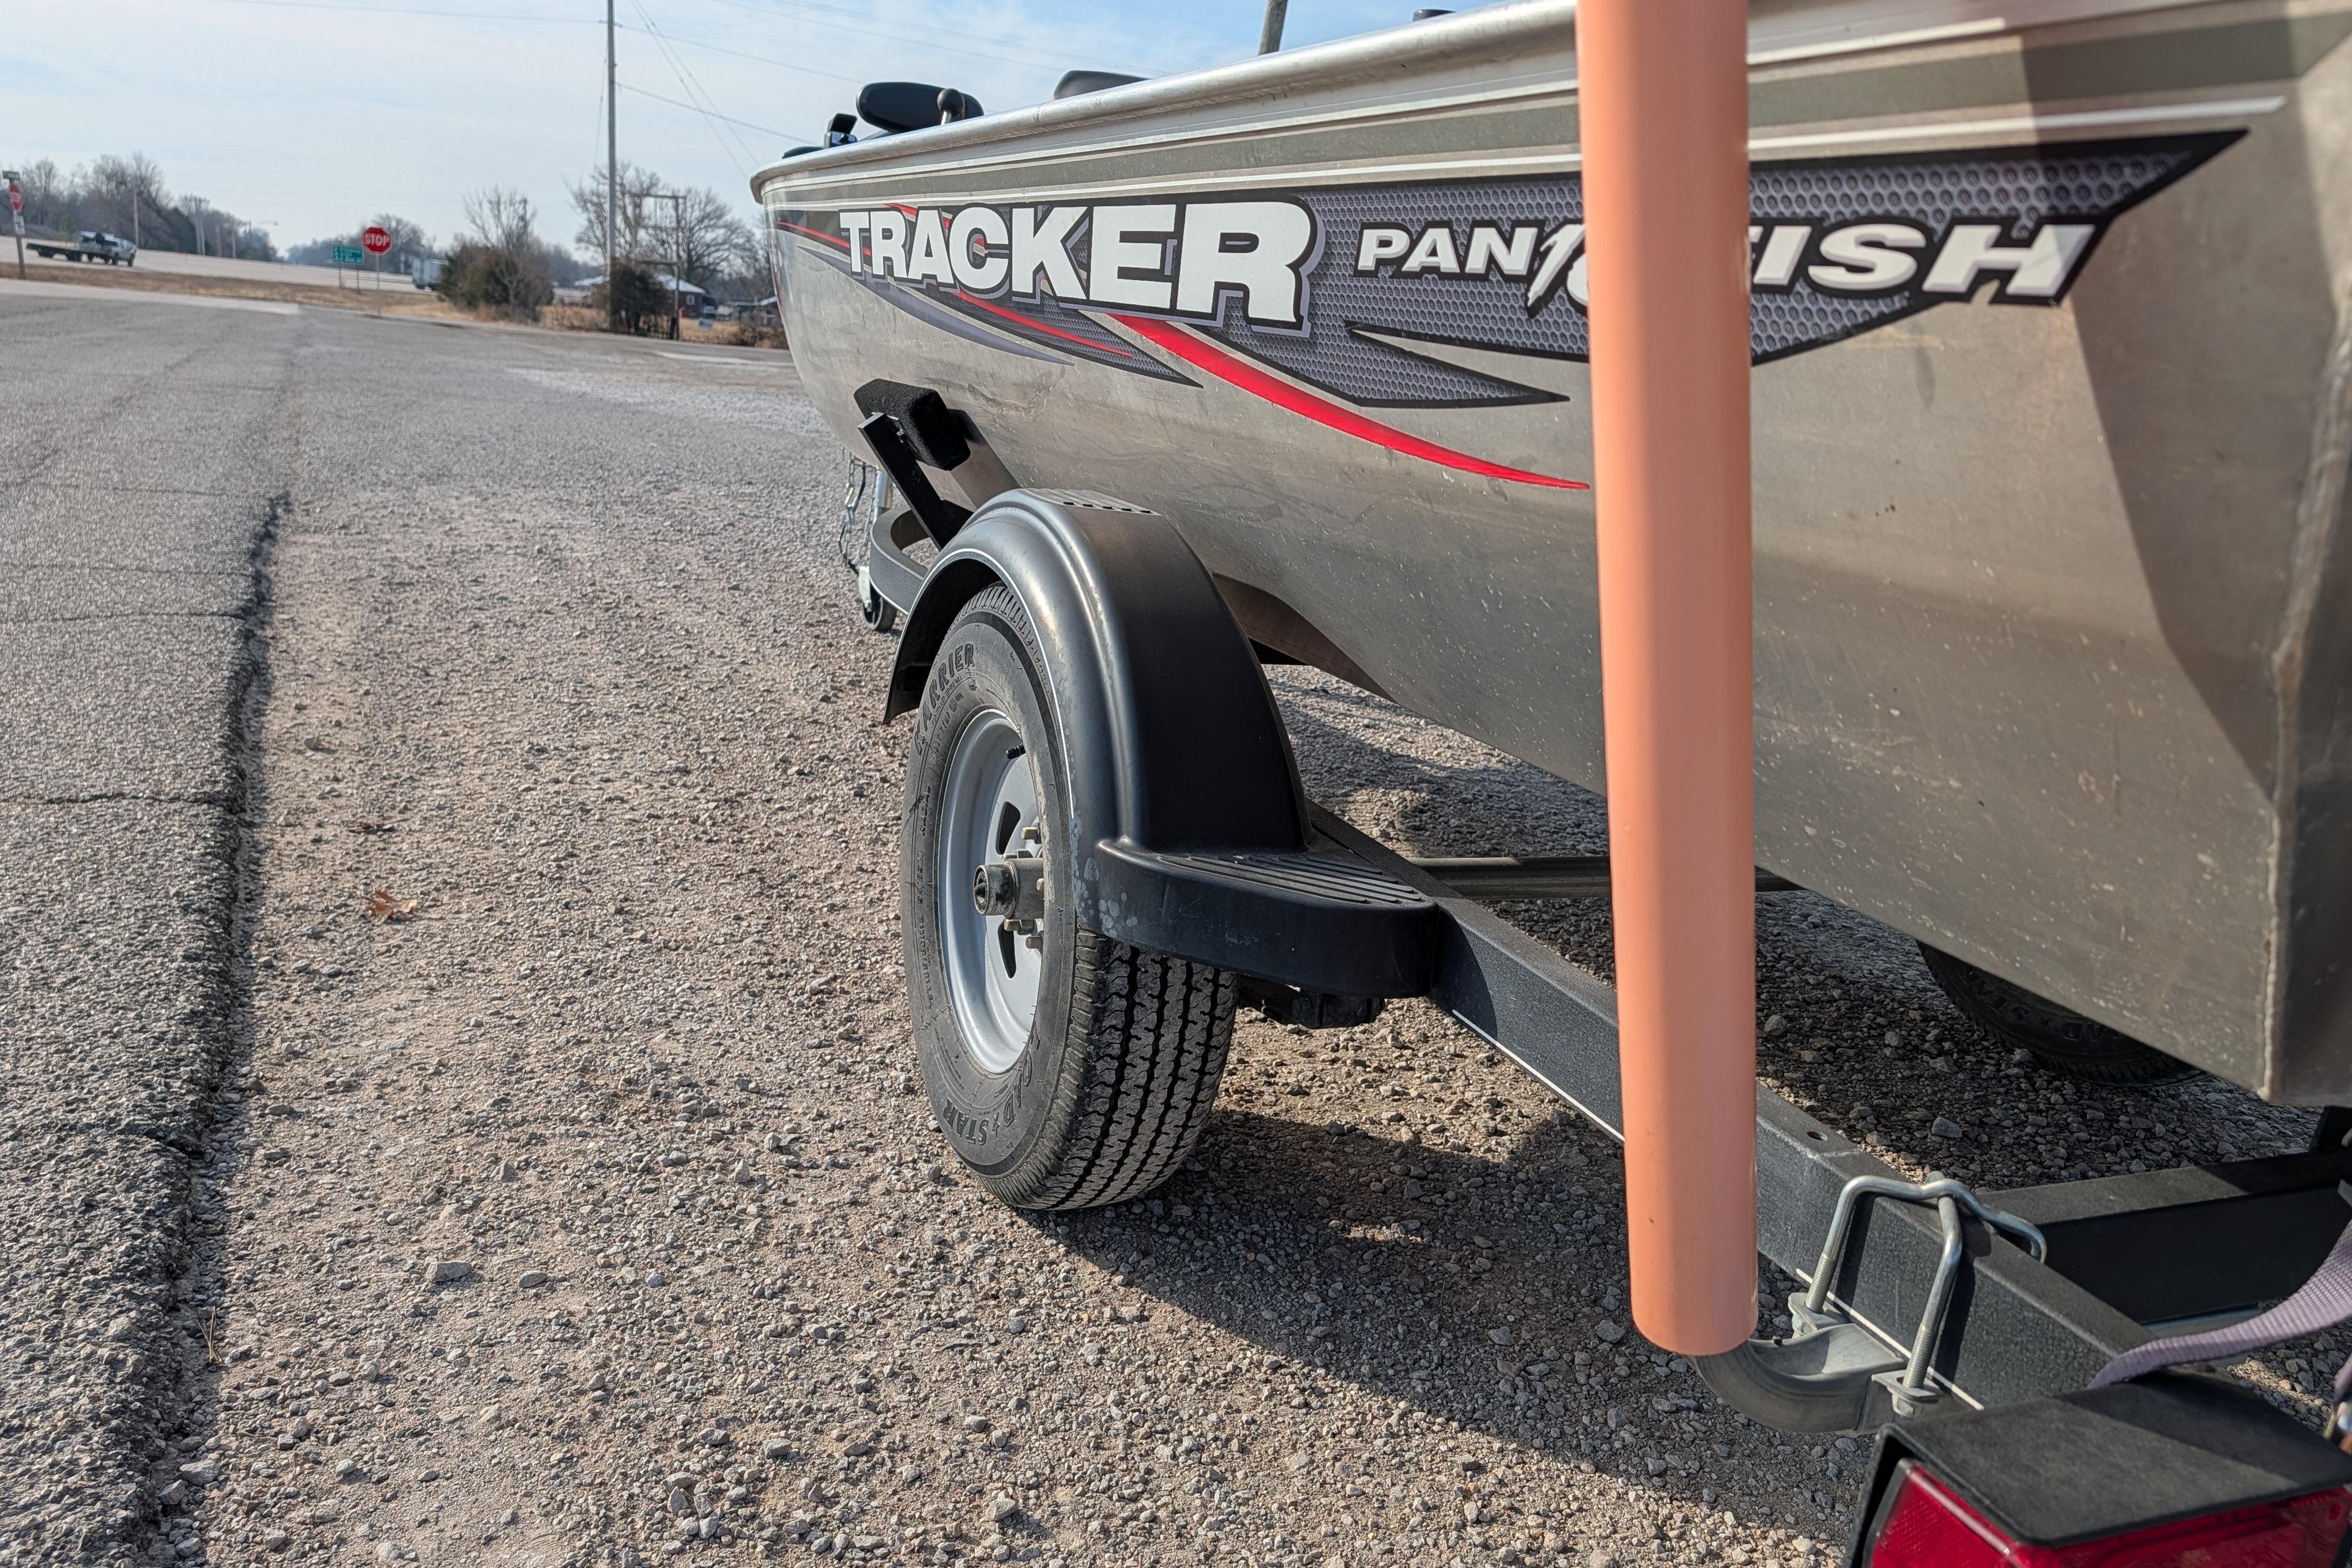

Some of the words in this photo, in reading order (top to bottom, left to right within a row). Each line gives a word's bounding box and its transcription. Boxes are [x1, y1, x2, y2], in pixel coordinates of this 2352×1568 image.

[364, 233, 390, 247] STOP
[839, 201, 1312, 323] TRACKER
[1357, 227, 1539, 276] PAN
[943, 1096, 989, 1146] STAR
